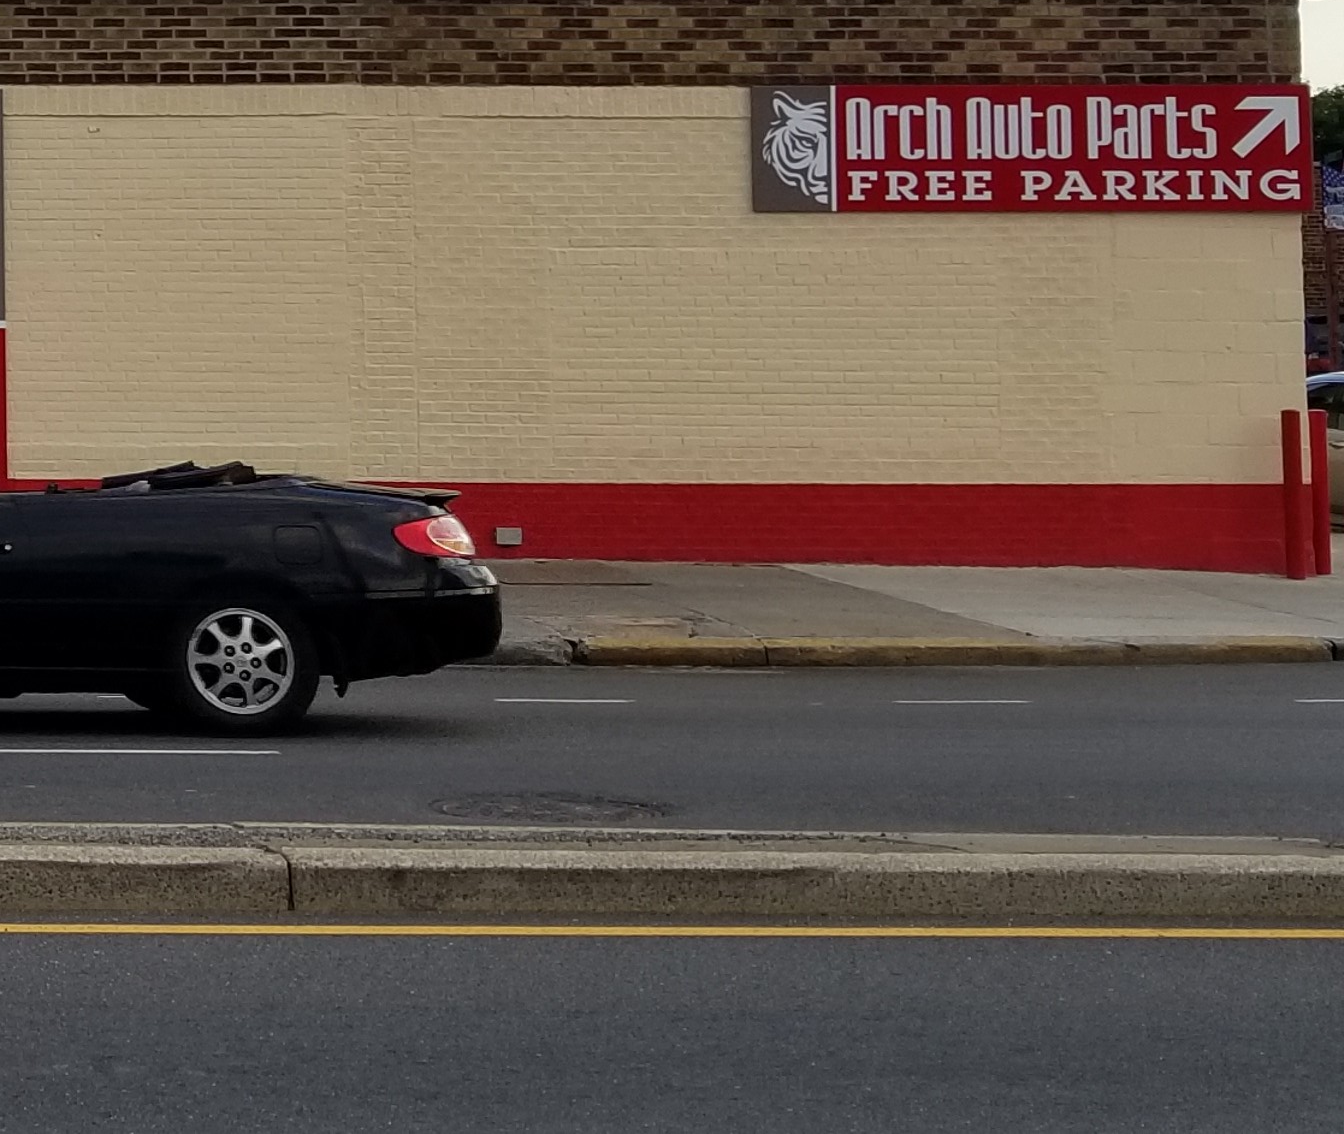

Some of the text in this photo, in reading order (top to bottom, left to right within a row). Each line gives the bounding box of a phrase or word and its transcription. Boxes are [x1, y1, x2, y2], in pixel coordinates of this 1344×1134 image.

[845, 96, 1218, 160] Arch Auto Parts
[847, 169, 1302, 202] FREE PARKING
